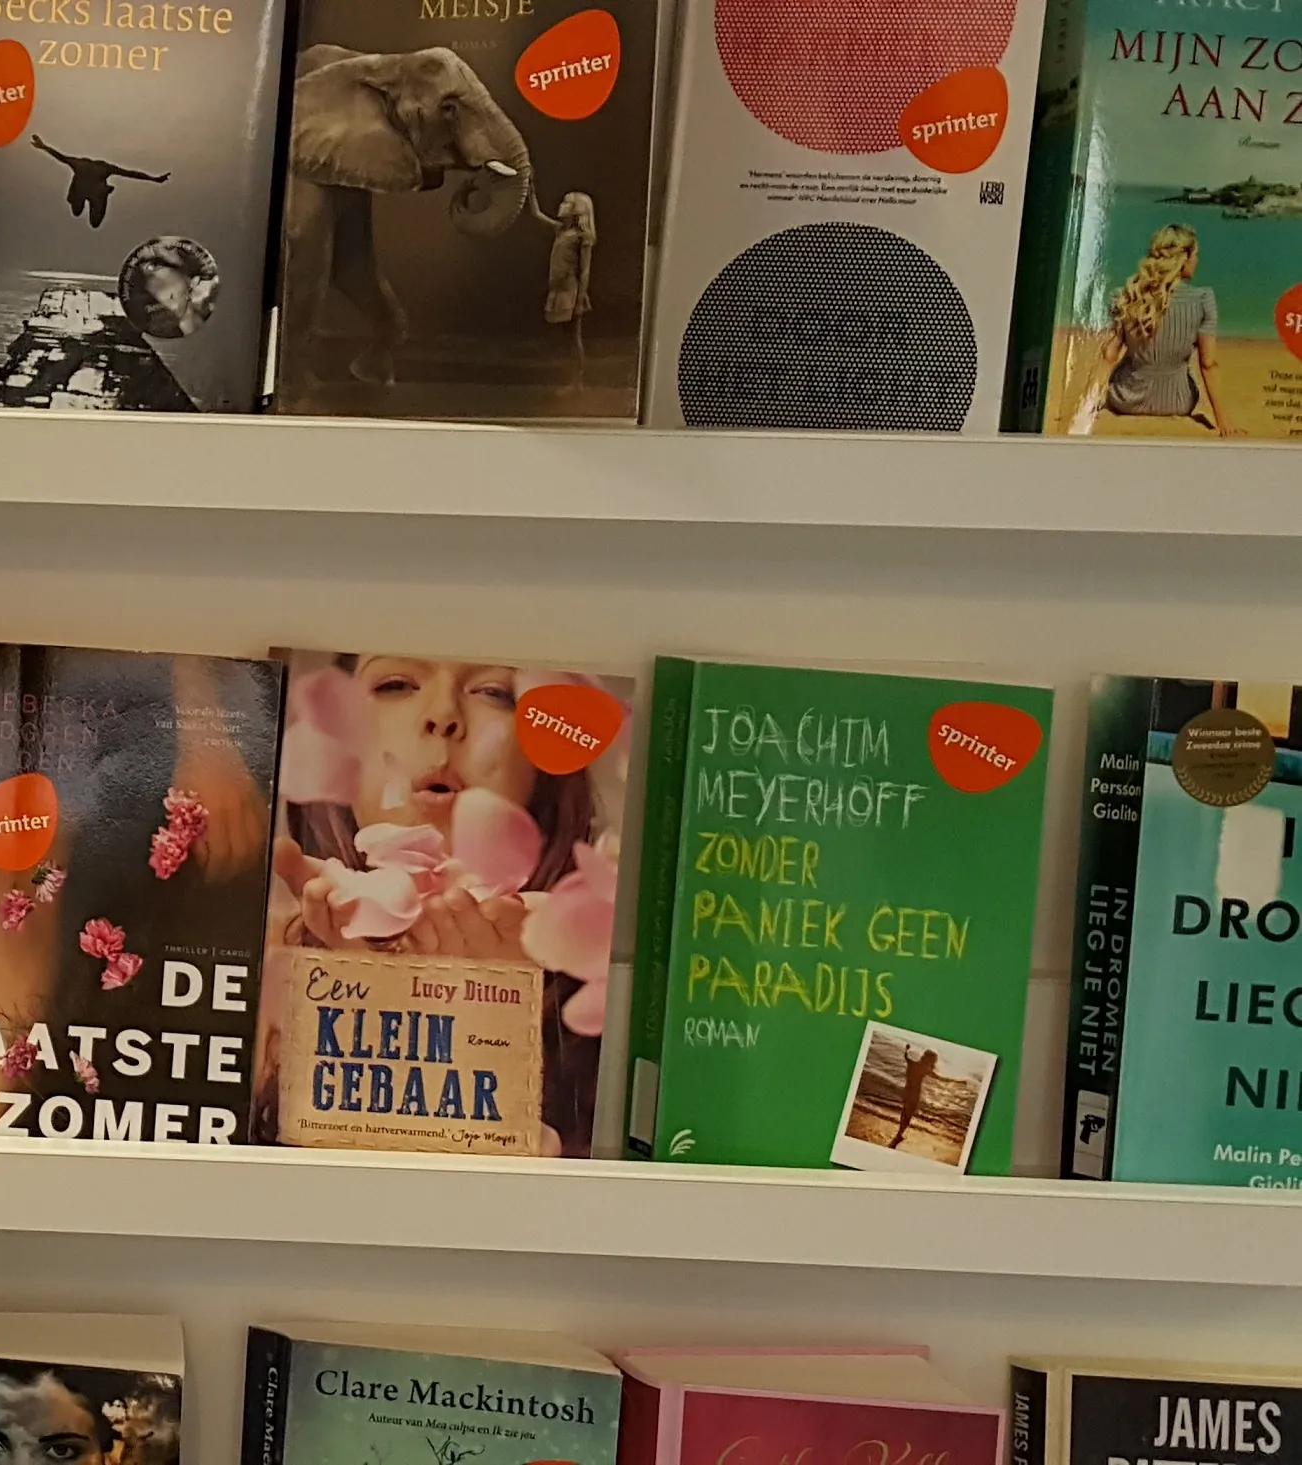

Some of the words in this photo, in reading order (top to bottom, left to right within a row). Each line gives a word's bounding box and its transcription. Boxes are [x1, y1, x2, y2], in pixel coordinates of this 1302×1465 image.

[103, 0, 233, 34] laatste
[419, 0, 535, 22] MEISJE
[38, 38, 169, 71] zomer
[451, 41, 498, 49] ROMAN
[1110, 28, 1225, 74] MIJN
[1241, 37, 1302, 72] ZO
[528, 53, 612, 91] sprinter
[1161, 84, 1267, 122] AAN
[911, 111, 999, 143] sprinter
[524, 704, 601, 752] sprinter
[702, 704, 890, 768] JOACHIM
[937, 721, 1017, 772] sprinter
[1100, 753, 1140, 771] Malin
[697, 766, 930, 829] MEYERHOFF
[1090, 778, 1142, 797] Persson
[1092, 803, 1138, 823] Giolito
[695, 829, 819, 889] ZONDER
[691, 890, 846, 952] PANIEK
[868, 905, 971, 960] GEEN
[1086, 885, 1110, 950] LIEG
[1113, 888, 1129, 920] IN
[1172, 894, 1300, 943] DRO
[163, 945, 208, 955] THRILLER
[160, 960, 248, 1012] DE
[306, 966, 372, 1001] Een
[411, 976, 458, 1004] Lucy
[687, 953, 893, 1018] PARADIJS
[1084, 960, 1102, 992] JE
[1101, 935, 1125, 1073] DROMEN
[314, 1006, 455, 1063] KLEIN
[467, 1035, 510, 1047] Roman
[683, 1016, 760, 1048] ROMAN
[1078, 1004, 1101, 1077] NIET
[312, 1060, 502, 1121] GEBAAR
[1226, 1066, 1302, 1112] NI
[451, 1129, 481, 1147] Jojo
[1213, 1144, 1272, 1165] Malin
[1278, 1148, 1302, 1167] Pe
[266, 1367, 278, 1418] Clare
[314, 1369, 399, 1401] Clare
[409, 1378, 595, 1425] Mackintosh
[368, 1412, 403, 1426] Auteur
[404, 1418, 424, 1428] van
[425, 1418, 446, 1431] Mea
[448, 1420, 476, 1436] culpa
[477, 1426, 491, 1435] en
[492, 1424, 503, 1436] Ik
[504, 1427, 518, 1438] zie
[519, 1430, 536, 1441] jou
[1013, 1392, 1030, 1452] JAMES
[1153, 1396, 1282, 1454] JAMES
